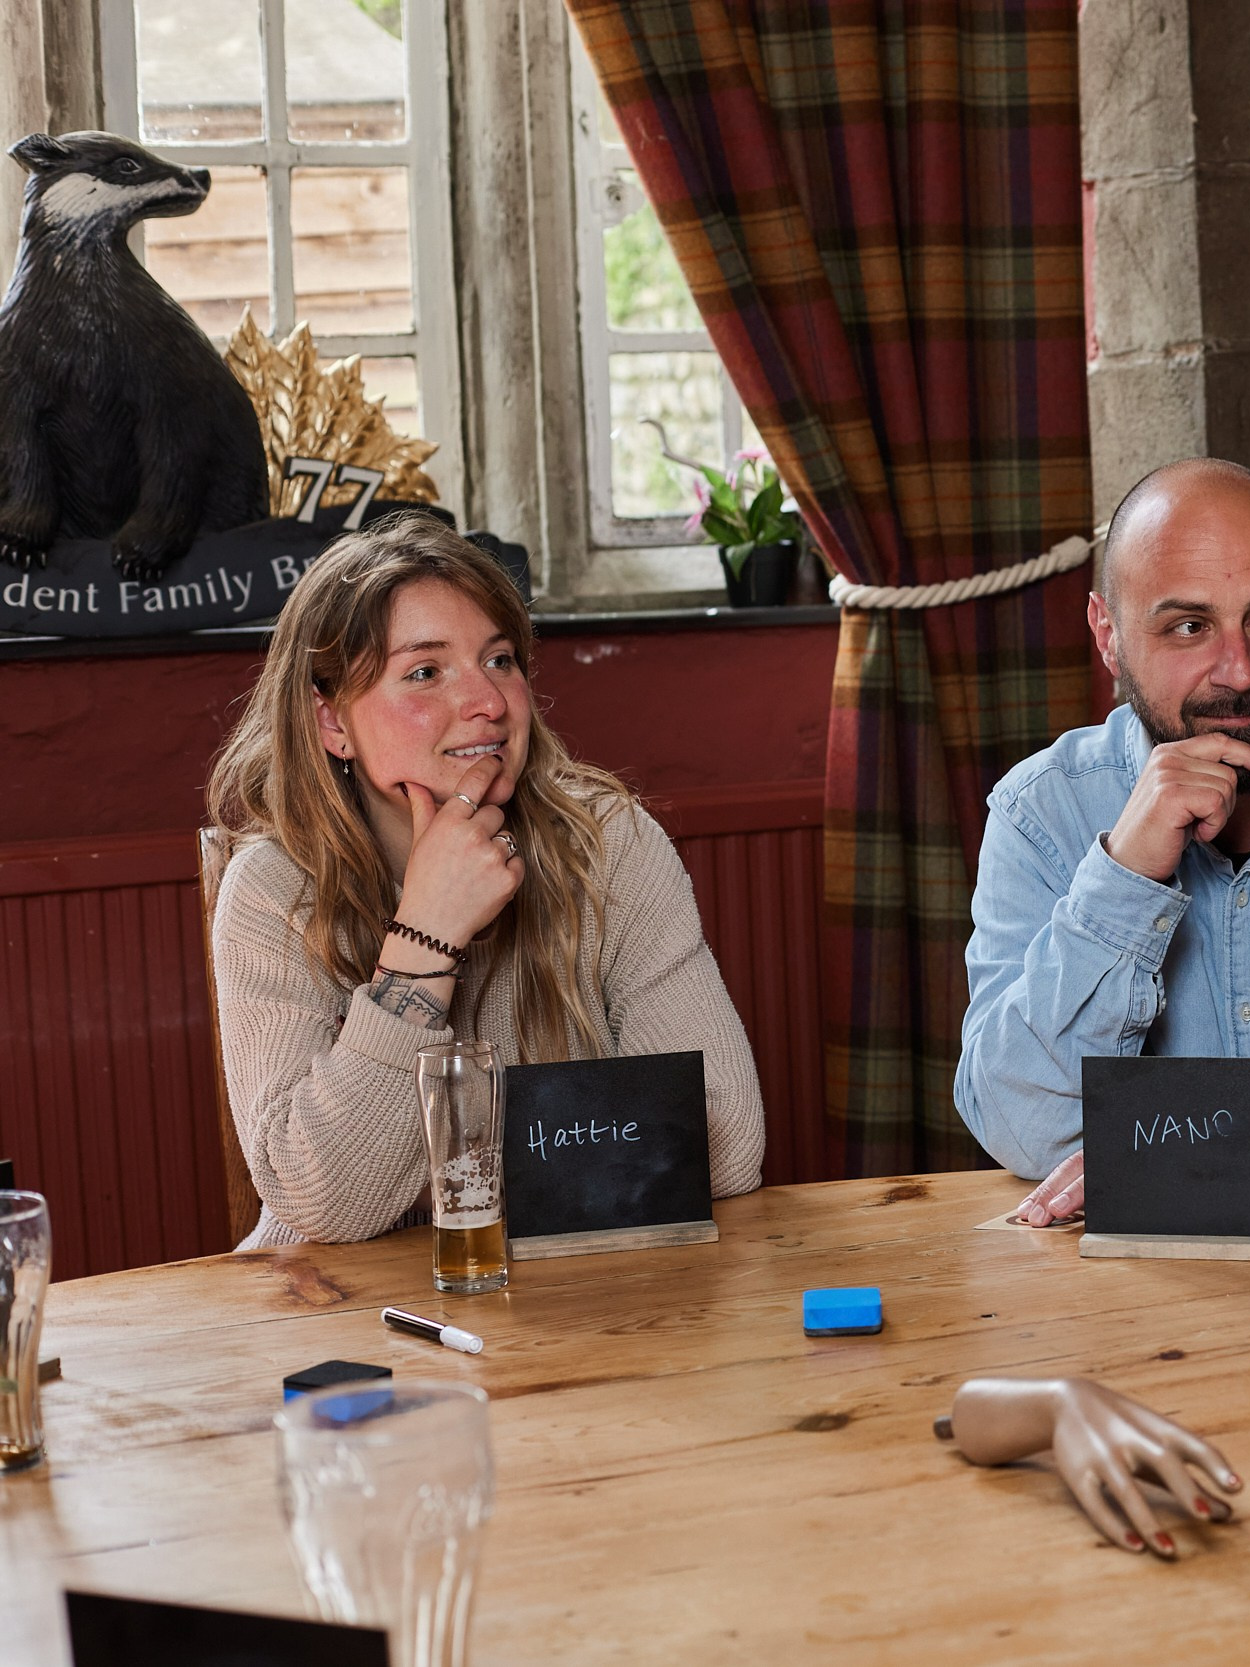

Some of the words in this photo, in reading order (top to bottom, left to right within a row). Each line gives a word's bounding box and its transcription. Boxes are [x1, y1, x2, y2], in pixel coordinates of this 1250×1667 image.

[288, 457, 384, 530] 77
[3, 573, 99, 613] dent
[119, 567, 252, 613] Family
[528, 1119, 641, 1161] Hattie
[1134, 1109, 1233, 1151] NANO
